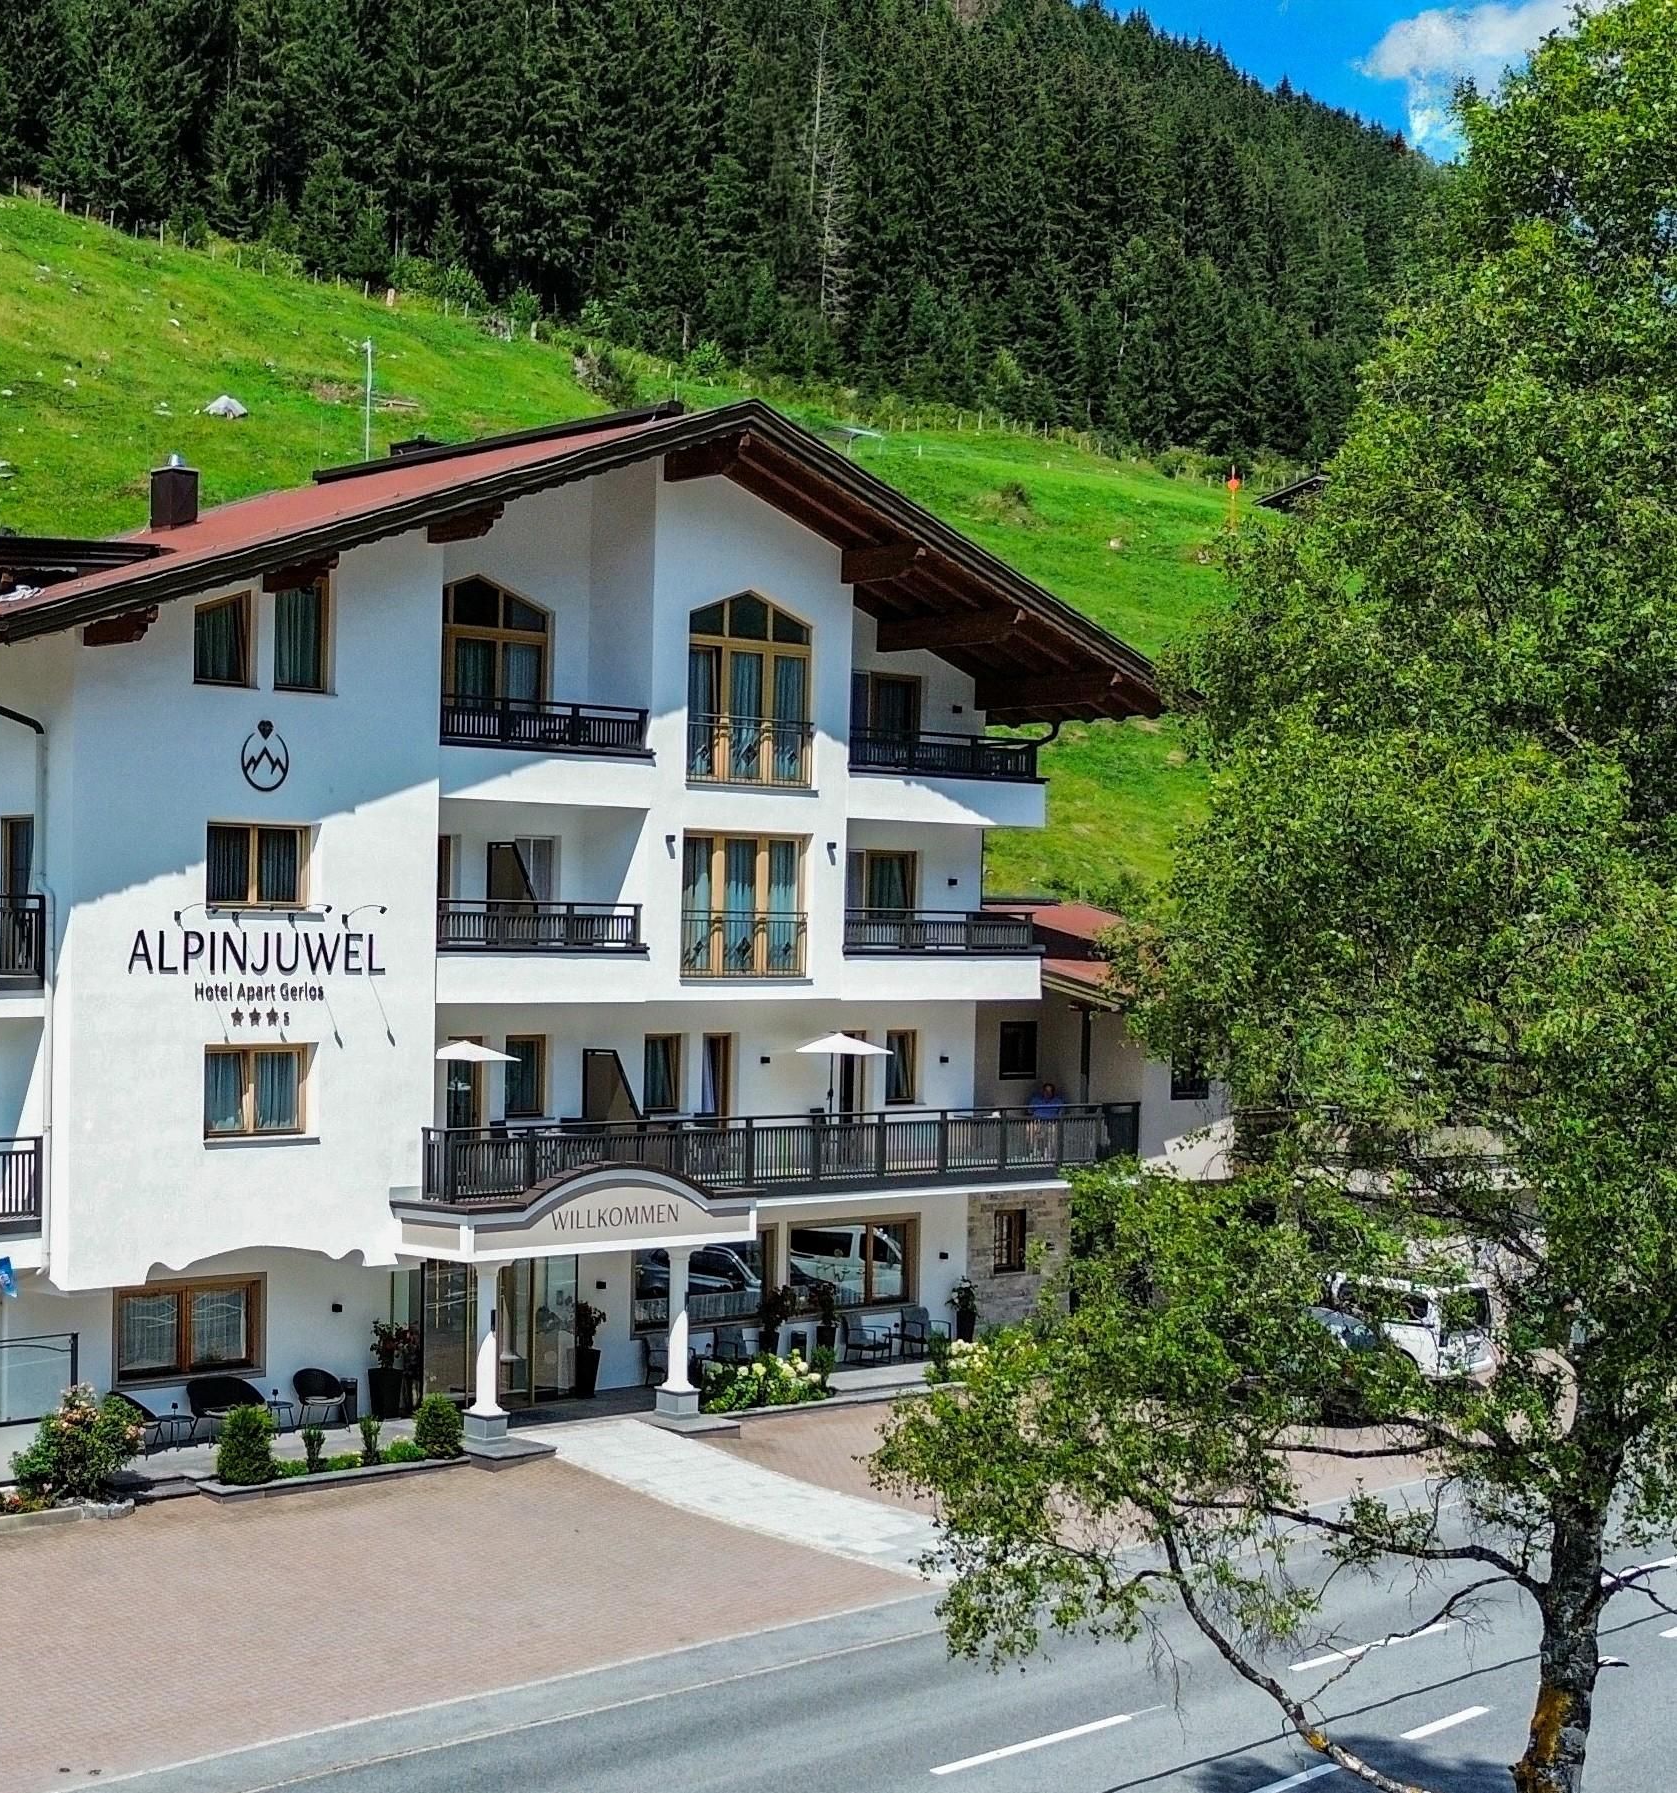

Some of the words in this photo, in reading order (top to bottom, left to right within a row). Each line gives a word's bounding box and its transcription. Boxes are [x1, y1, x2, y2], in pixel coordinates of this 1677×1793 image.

[128, 929, 386, 976] ALPINJUWEL
[194, 982, 233, 1002] Hotel
[237, 982, 274, 1005] Apart
[280, 982, 324, 1002] Gerlos
[551, 1203, 680, 1231] WILLKOMMEN
